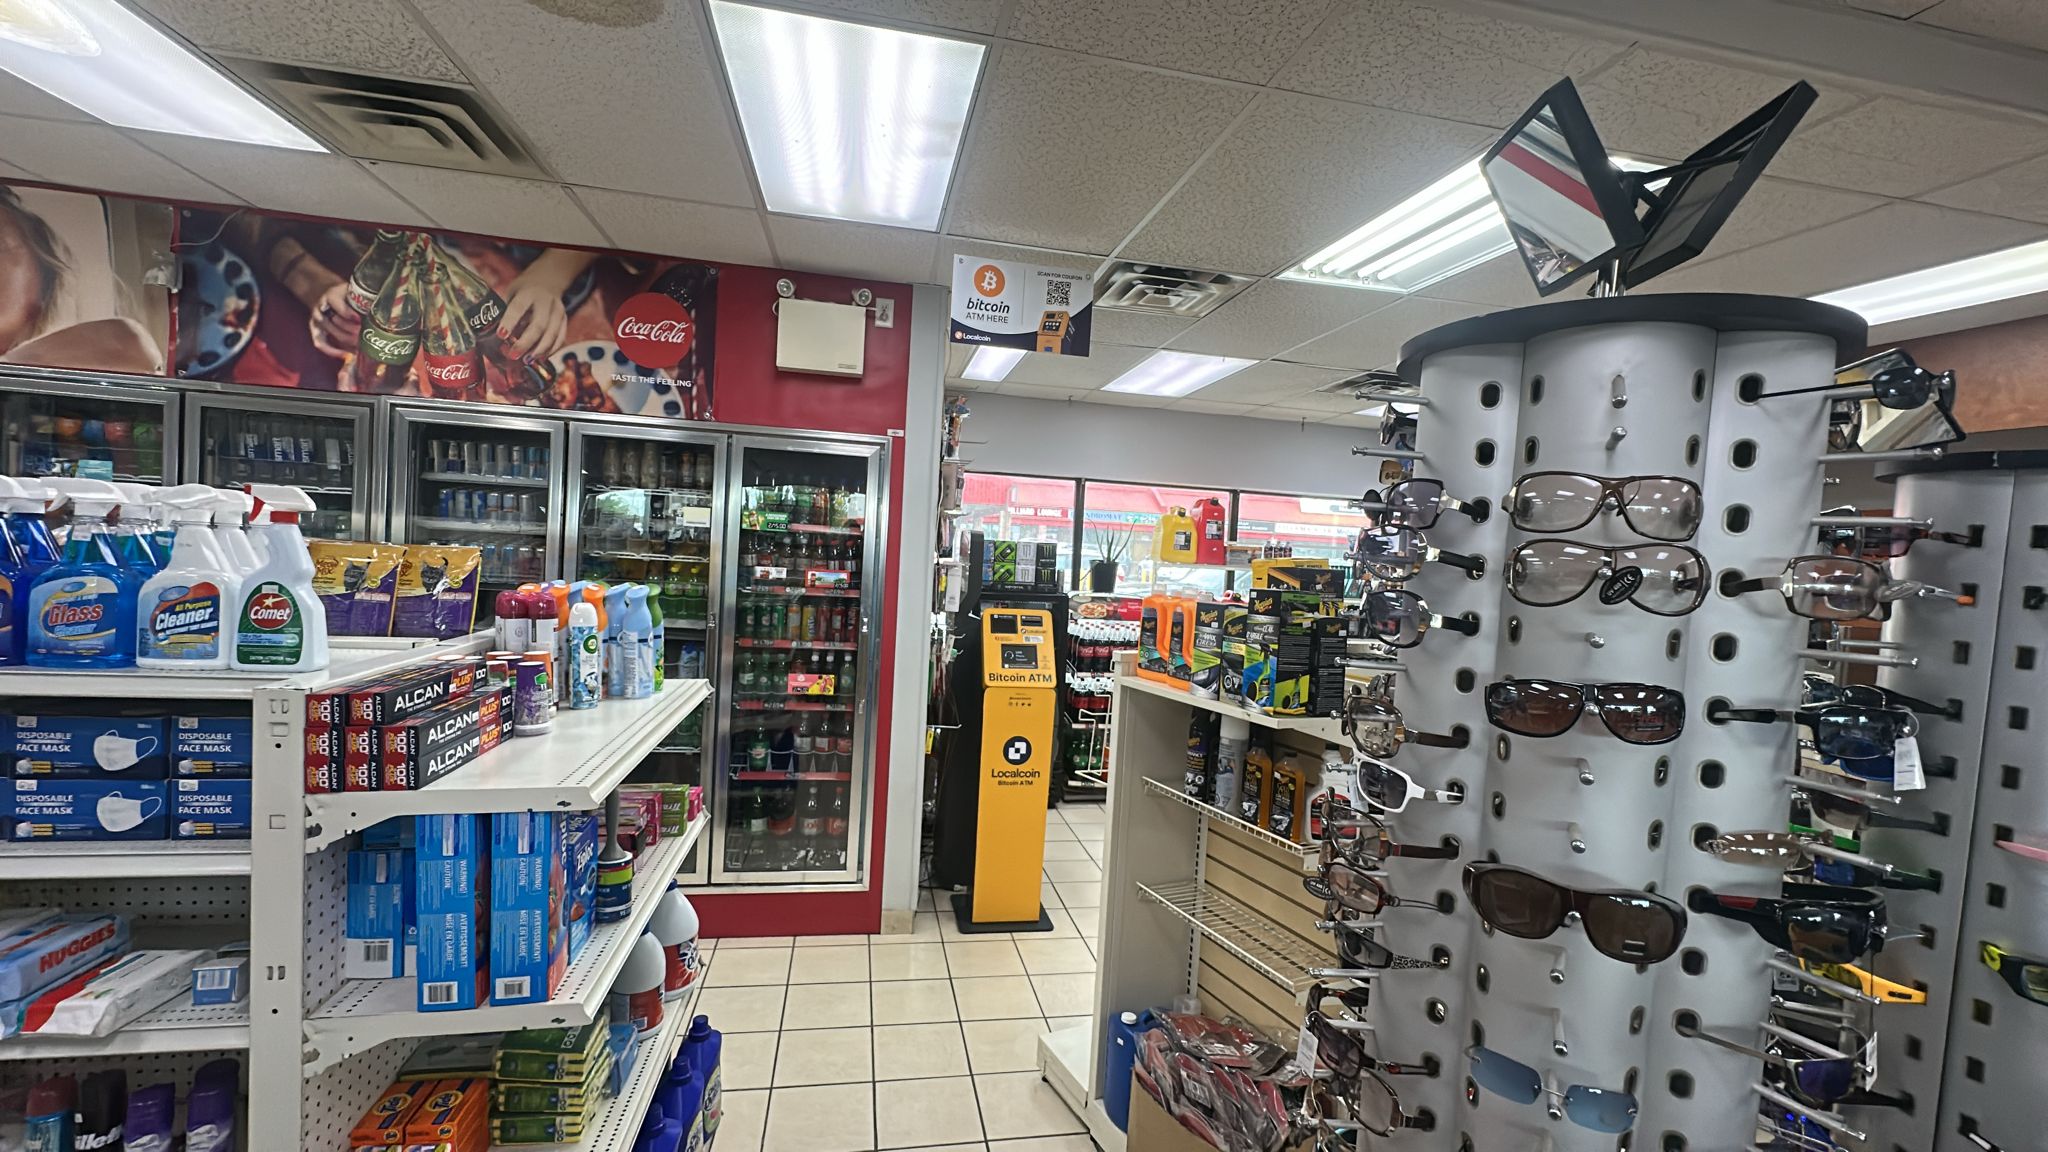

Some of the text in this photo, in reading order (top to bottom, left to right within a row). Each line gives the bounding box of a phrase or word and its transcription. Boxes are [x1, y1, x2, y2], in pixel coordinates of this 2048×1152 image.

[966, 298, 1010, 314] bitcoin
[966, 312, 1009, 324] ATM HERE
[963, 333, 991, 342] Localcoin
[611, 374, 692, 388] TASTE THE FEELING
[48, 603, 103, 627] Glass
[250, 605, 290, 620] Comet
[155, 607, 214, 631] Cleaner
[988, 673, 1052, 683] Bitcoin ATM
[394, 681, 444, 713] ALCAN
[427, 710, 473, 745] ALCAN
[16, 732, 72, 740] DISPOSABLE
[178, 732, 232, 740] DISPOSABLE
[16, 743, 71, 753] FACE MASK
[178, 744, 232, 753] FACE MASK
[427, 739, 473, 776] ALCAN
[991, 768, 1040, 778] Localcoin
[16, 794, 73, 802] DISPOSABLE
[178, 794, 232, 802] DISPOSABLE
[16, 806, 73, 815] FACE MASK
[178, 806, 232, 814] FACE MASK
[38, 922, 116, 974] HUGGIES
